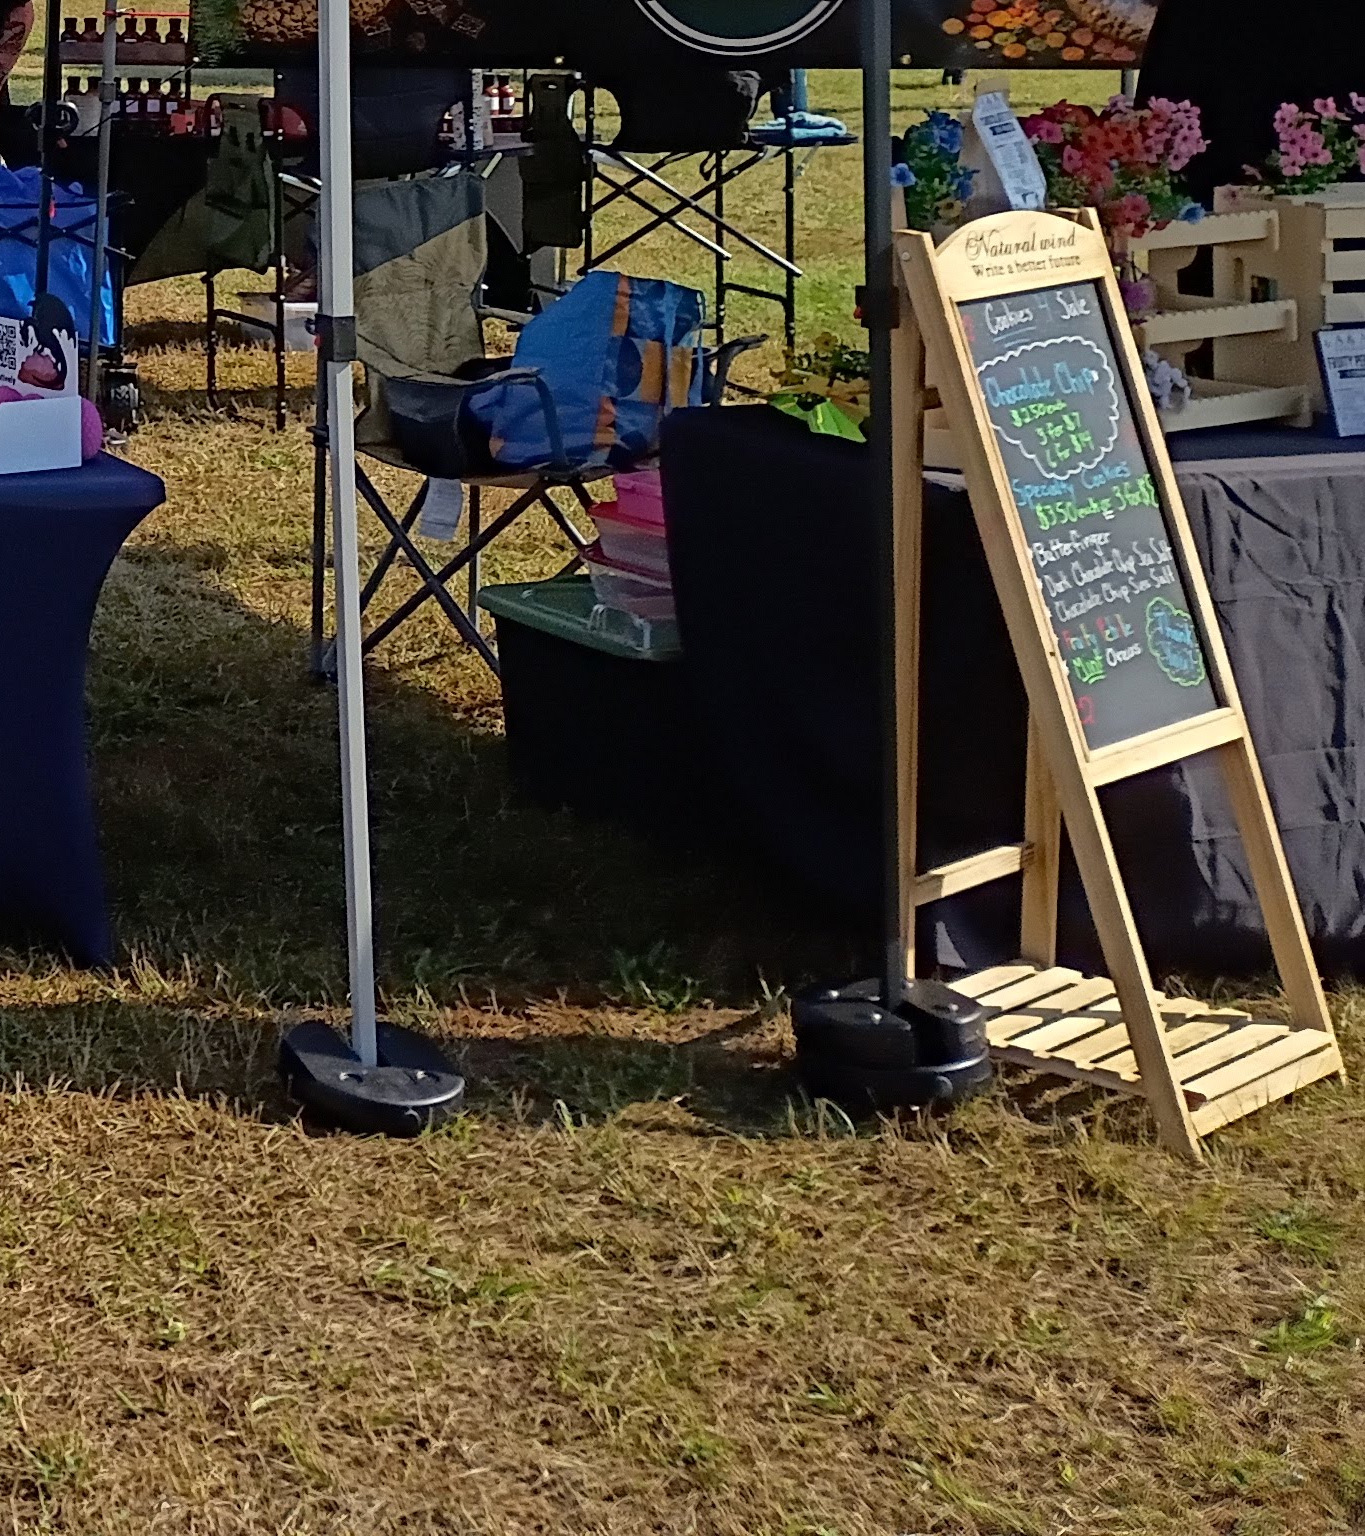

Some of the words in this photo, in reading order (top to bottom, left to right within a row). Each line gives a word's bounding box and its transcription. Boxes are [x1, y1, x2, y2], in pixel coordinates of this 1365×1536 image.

[965, 227, 1037, 262] Natural
[1040, 226, 1076, 250] wind
[971, 264, 1005, 278] Write
[1015, 260, 1047, 272] better
[1048, 254, 1081, 268] future
[985, 301, 1034, 335] Cookies
[1056, 290, 1091, 320] Sale
[985, 366, 1055, 408] Chocolate
[1053, 362, 1095, 395] Chip
[1012, 478, 1077, 510] Specialty
[1081, 460, 1131, 489] Cookies
[1033, 530, 1112, 567] Butterfinger
[1044, 570, 1072, 598] Dark
[1071, 553, 1114, 586] Chocolate
[1132, 541, 1154, 567] Sea
[1149, 537, 1173, 563] Salt
[1054, 588, 1103, 623] Chocolate
[1101, 582, 1131, 604] Chip
[1127, 576, 1152, 595] Sea
[1149, 565, 1176, 589] Salt
[1106, 642, 1142, 667] Oreos
